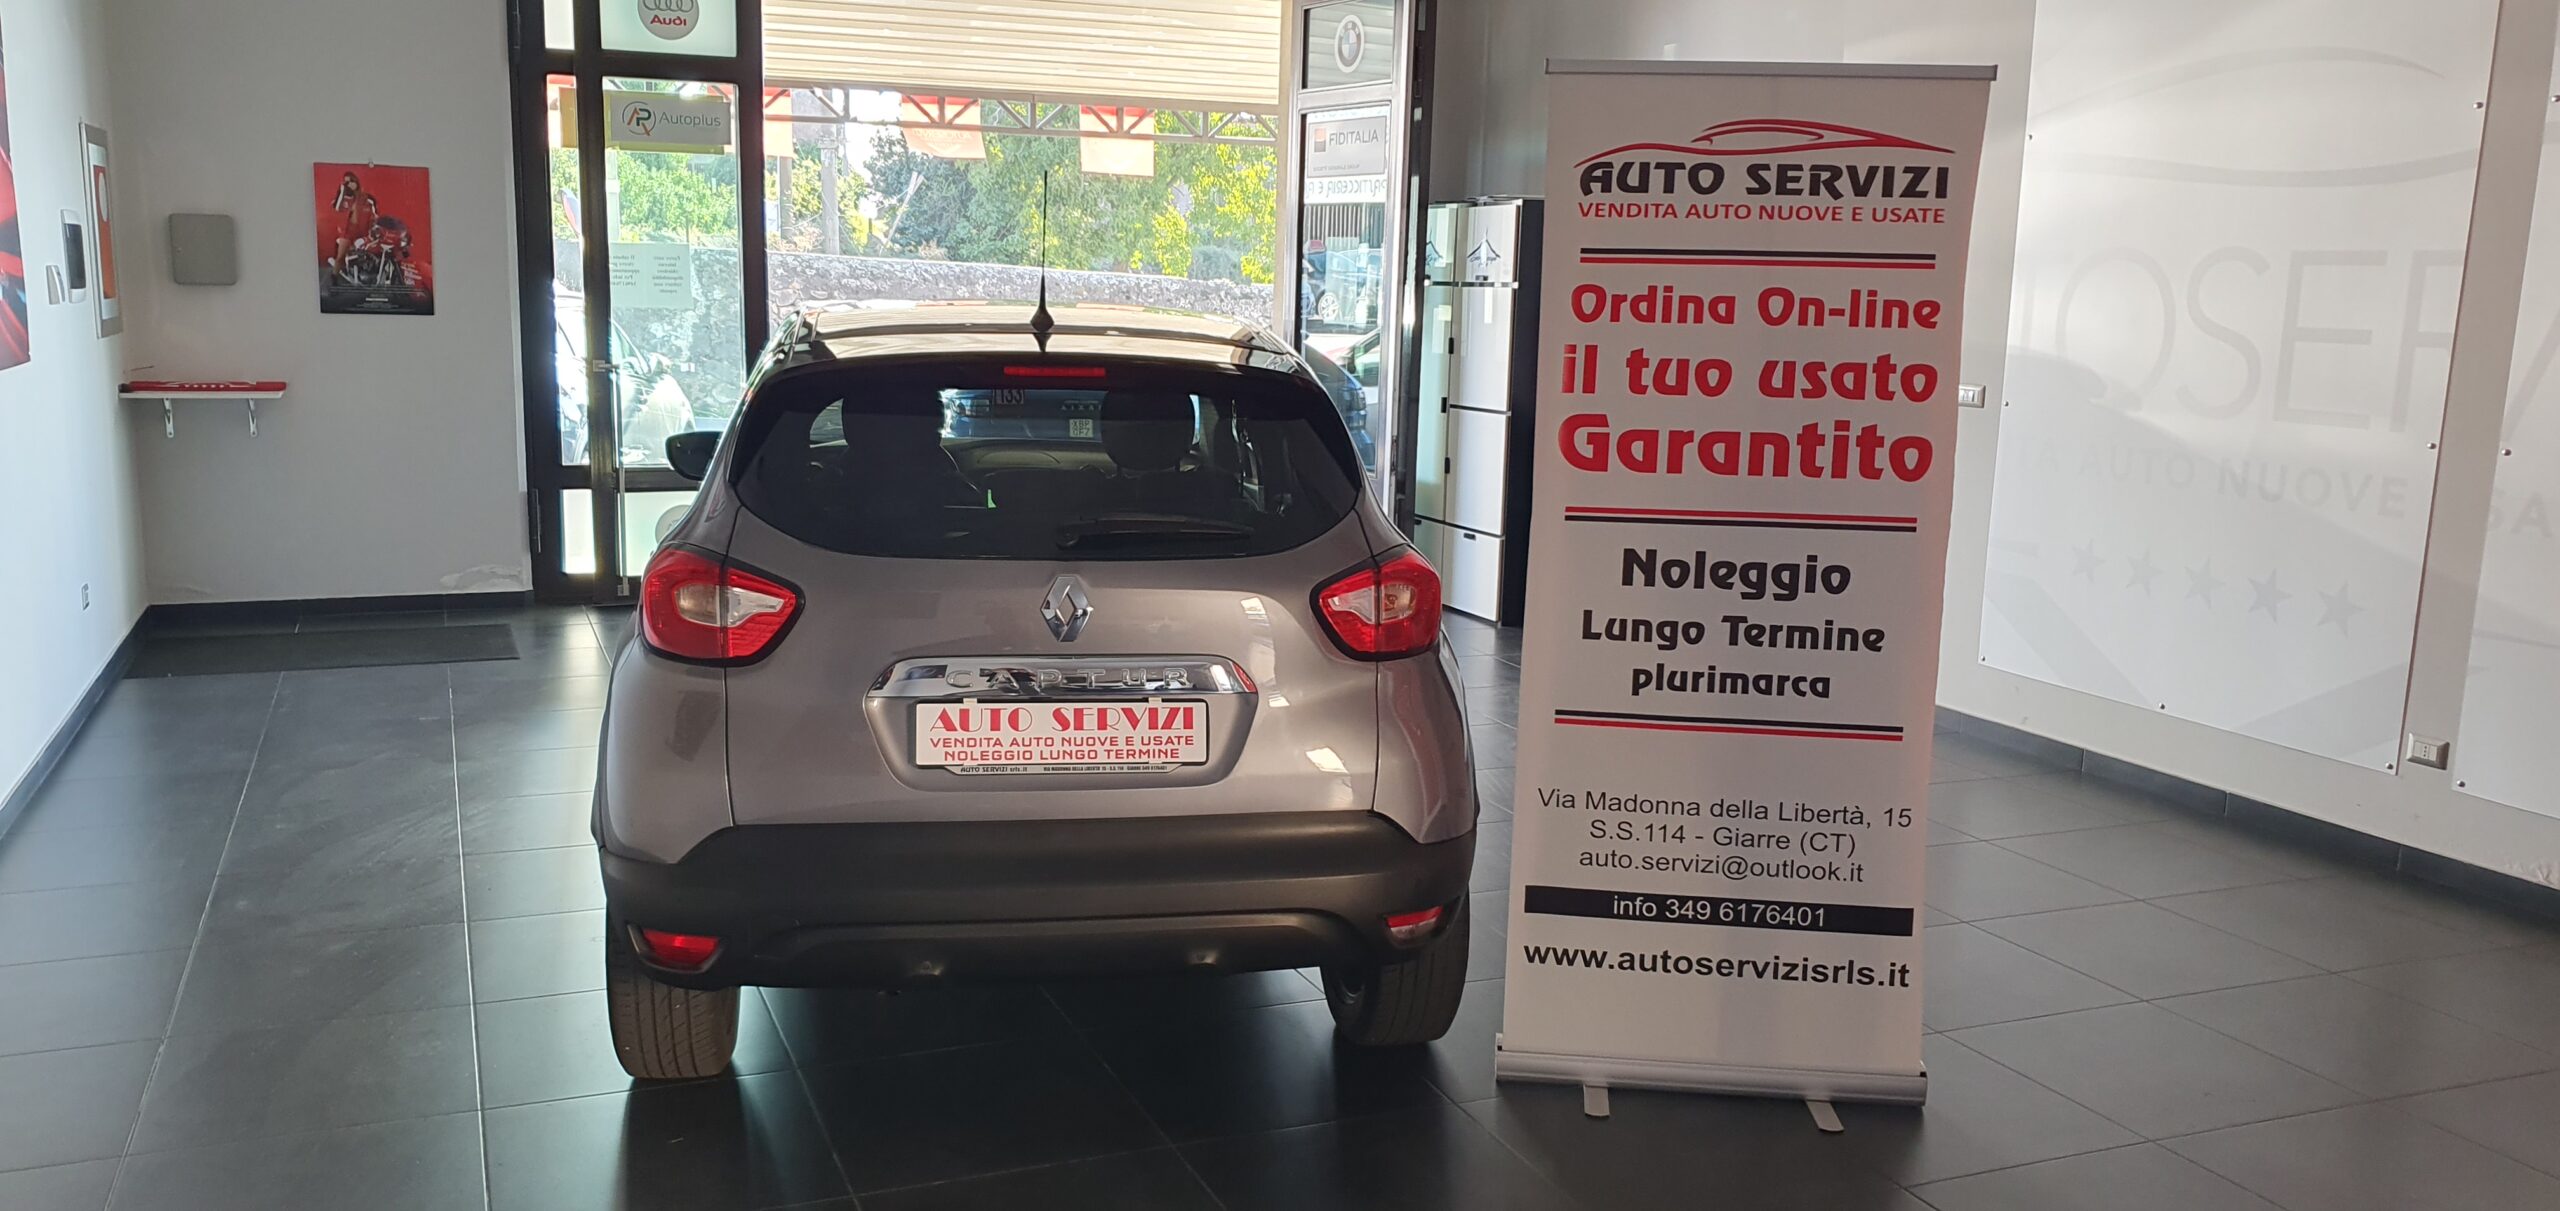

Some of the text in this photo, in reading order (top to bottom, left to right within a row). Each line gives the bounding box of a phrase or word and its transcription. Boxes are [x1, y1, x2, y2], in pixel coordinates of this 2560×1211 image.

[650, 14, 687, 26] Audi
[659, 111, 721, 128] Autoplus
[1329, 128, 1379, 147] FIDITALIA
[1579, 161, 1950, 201] AUTO SERVIZI
[1578, 201, 1945, 224] VENDITA AUTO NUOVE E USATE
[1570, 283, 1942, 330] Ordina On-line
[1560, 344, 1939, 403] il tuo usato
[1557, 413, 1934, 483] Garantito
[2217, 458, 2409, 519] NUOVE
[1621, 547, 1852, 602] Noleggio
[1581, 609, 1886, 653] Lungo Termine
[945, 667, 1191, 690] CAPTUR
[1631, 662, 1831, 699] plurimarca
[929, 705, 1195, 733] AUTO SERVIZI
[929, 734, 1195, 749] VENDITA AUTO NUOVE E USATE
[944, 747, 1180, 762] NOLEGGIO LUNGO TERMINE
[1537, 787, 1912, 829] Via Madonna della Libertà, 15
[1589, 819, 1686, 845] S.S.114
[1713, 827, 1792, 851] Giarre
[1800, 831, 1857, 859] (CT)
[1578, 849, 1864, 883] auto.servizi@outlook.it
[1612, 896, 1826, 928] info 349 6176401
[1523, 944, 1911, 988] www.autoservizisrls.it
